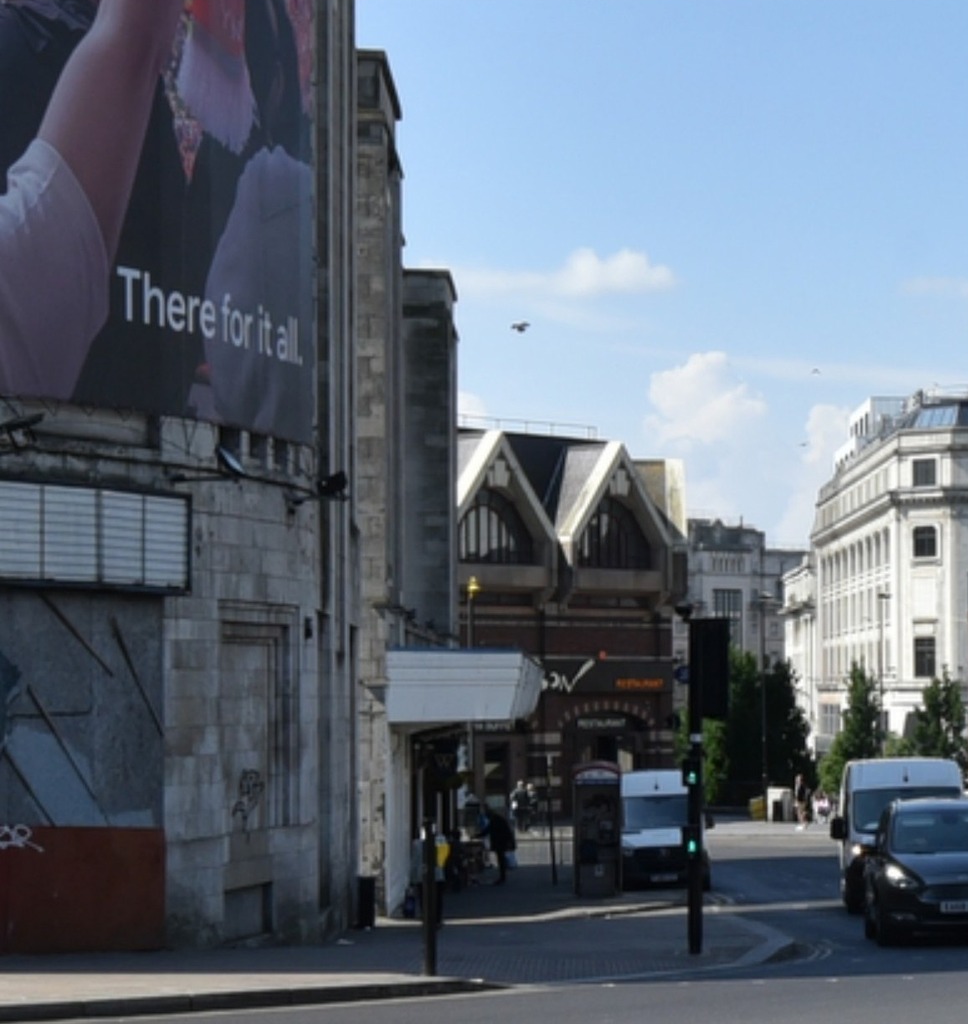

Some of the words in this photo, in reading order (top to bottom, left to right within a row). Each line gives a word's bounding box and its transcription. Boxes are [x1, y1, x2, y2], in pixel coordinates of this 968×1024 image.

[116, 265, 217, 340] There
[221, 292, 254, 350] for
[258, 304, 273, 357] it
[276, 315, 304, 366] all.
